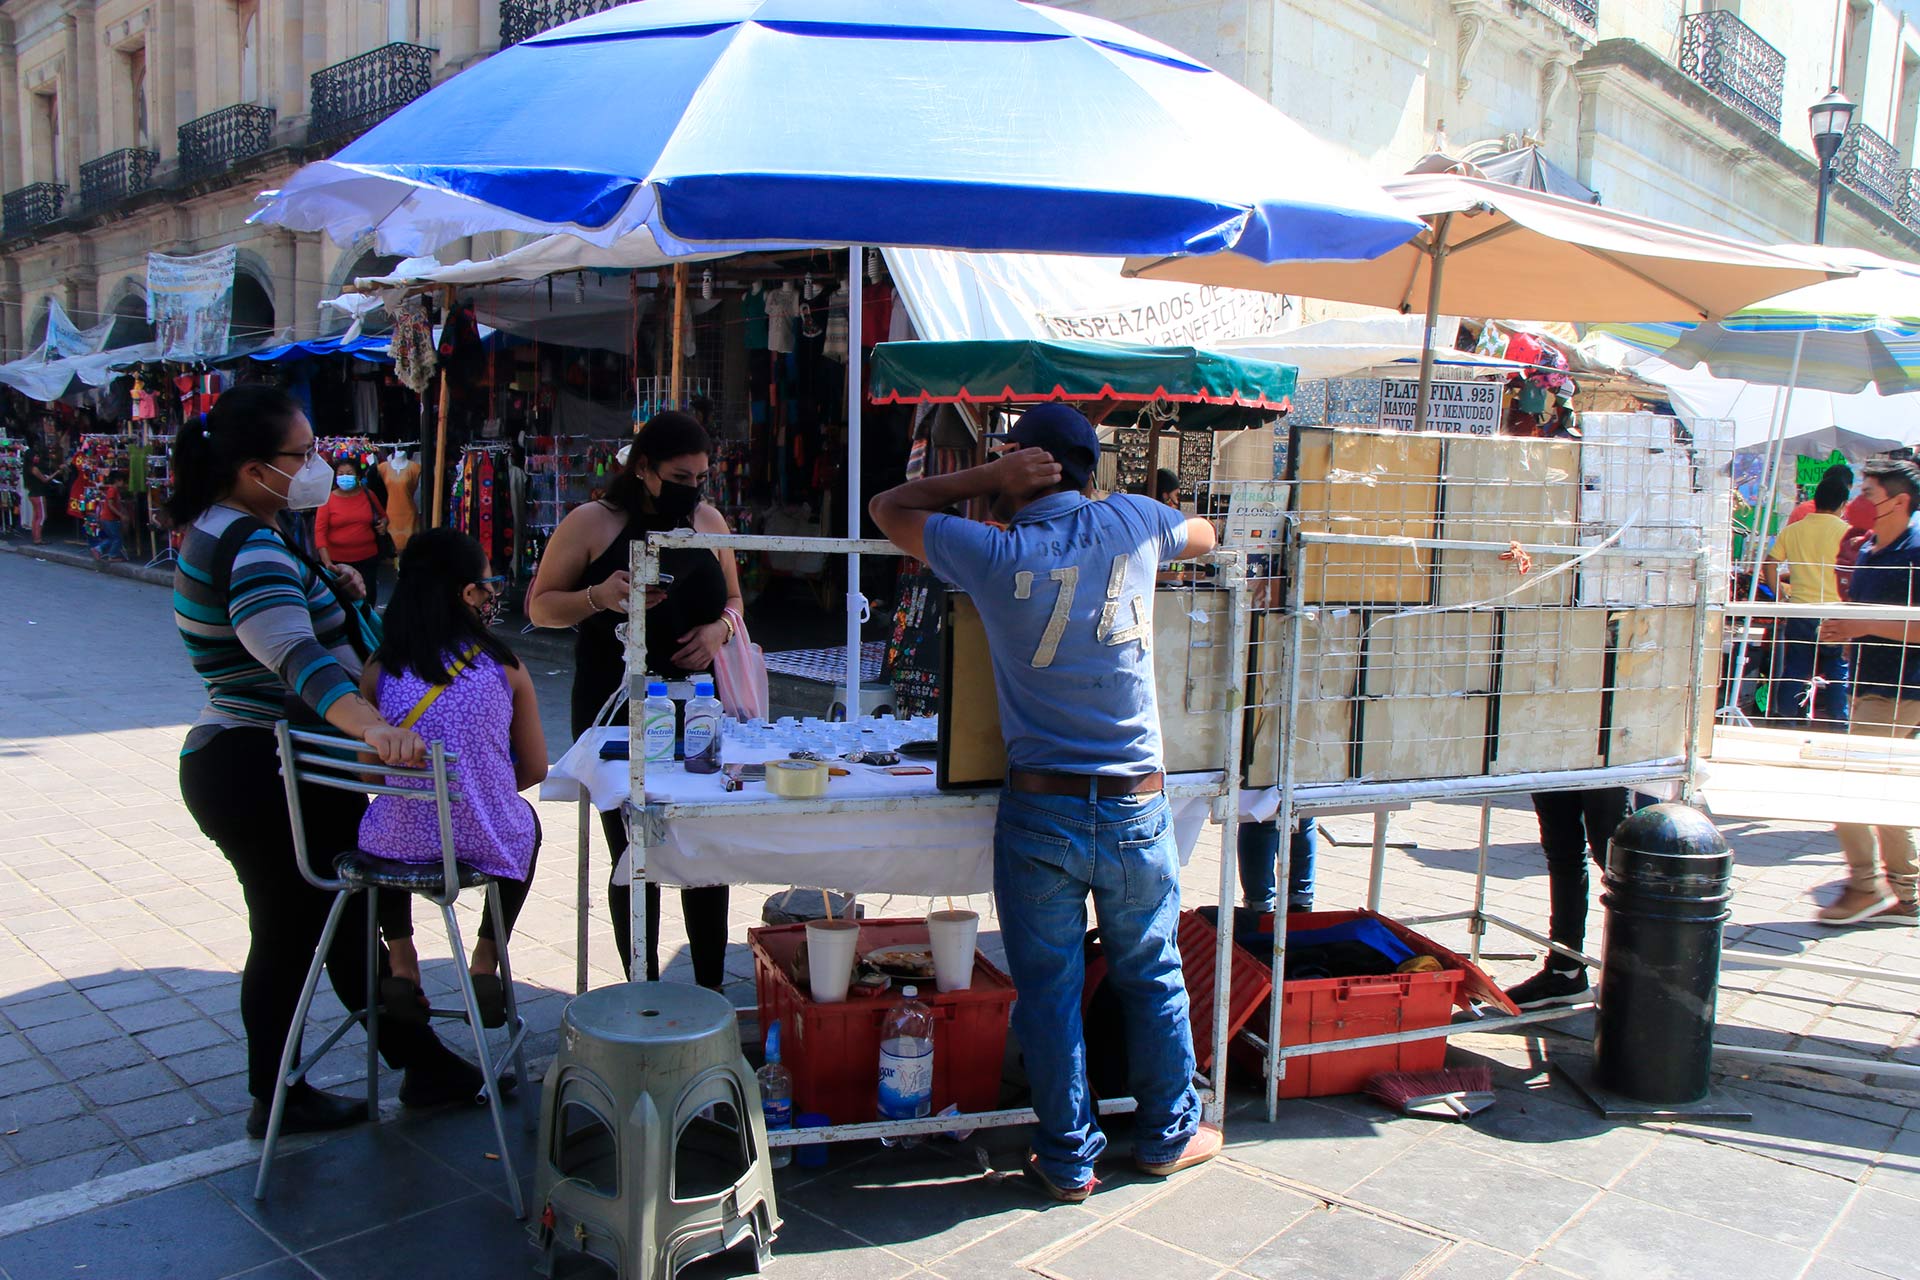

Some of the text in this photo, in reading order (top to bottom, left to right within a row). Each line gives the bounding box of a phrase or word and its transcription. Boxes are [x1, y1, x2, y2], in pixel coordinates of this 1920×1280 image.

[1053, 291, 1194, 338] DESPLAZADOS
[1385, 382, 1495, 403] PLAT FINA .925
[1383, 401, 1494, 421] MAYOR Y MENUDEO
[1425, 420, 1462, 434] ILVER
